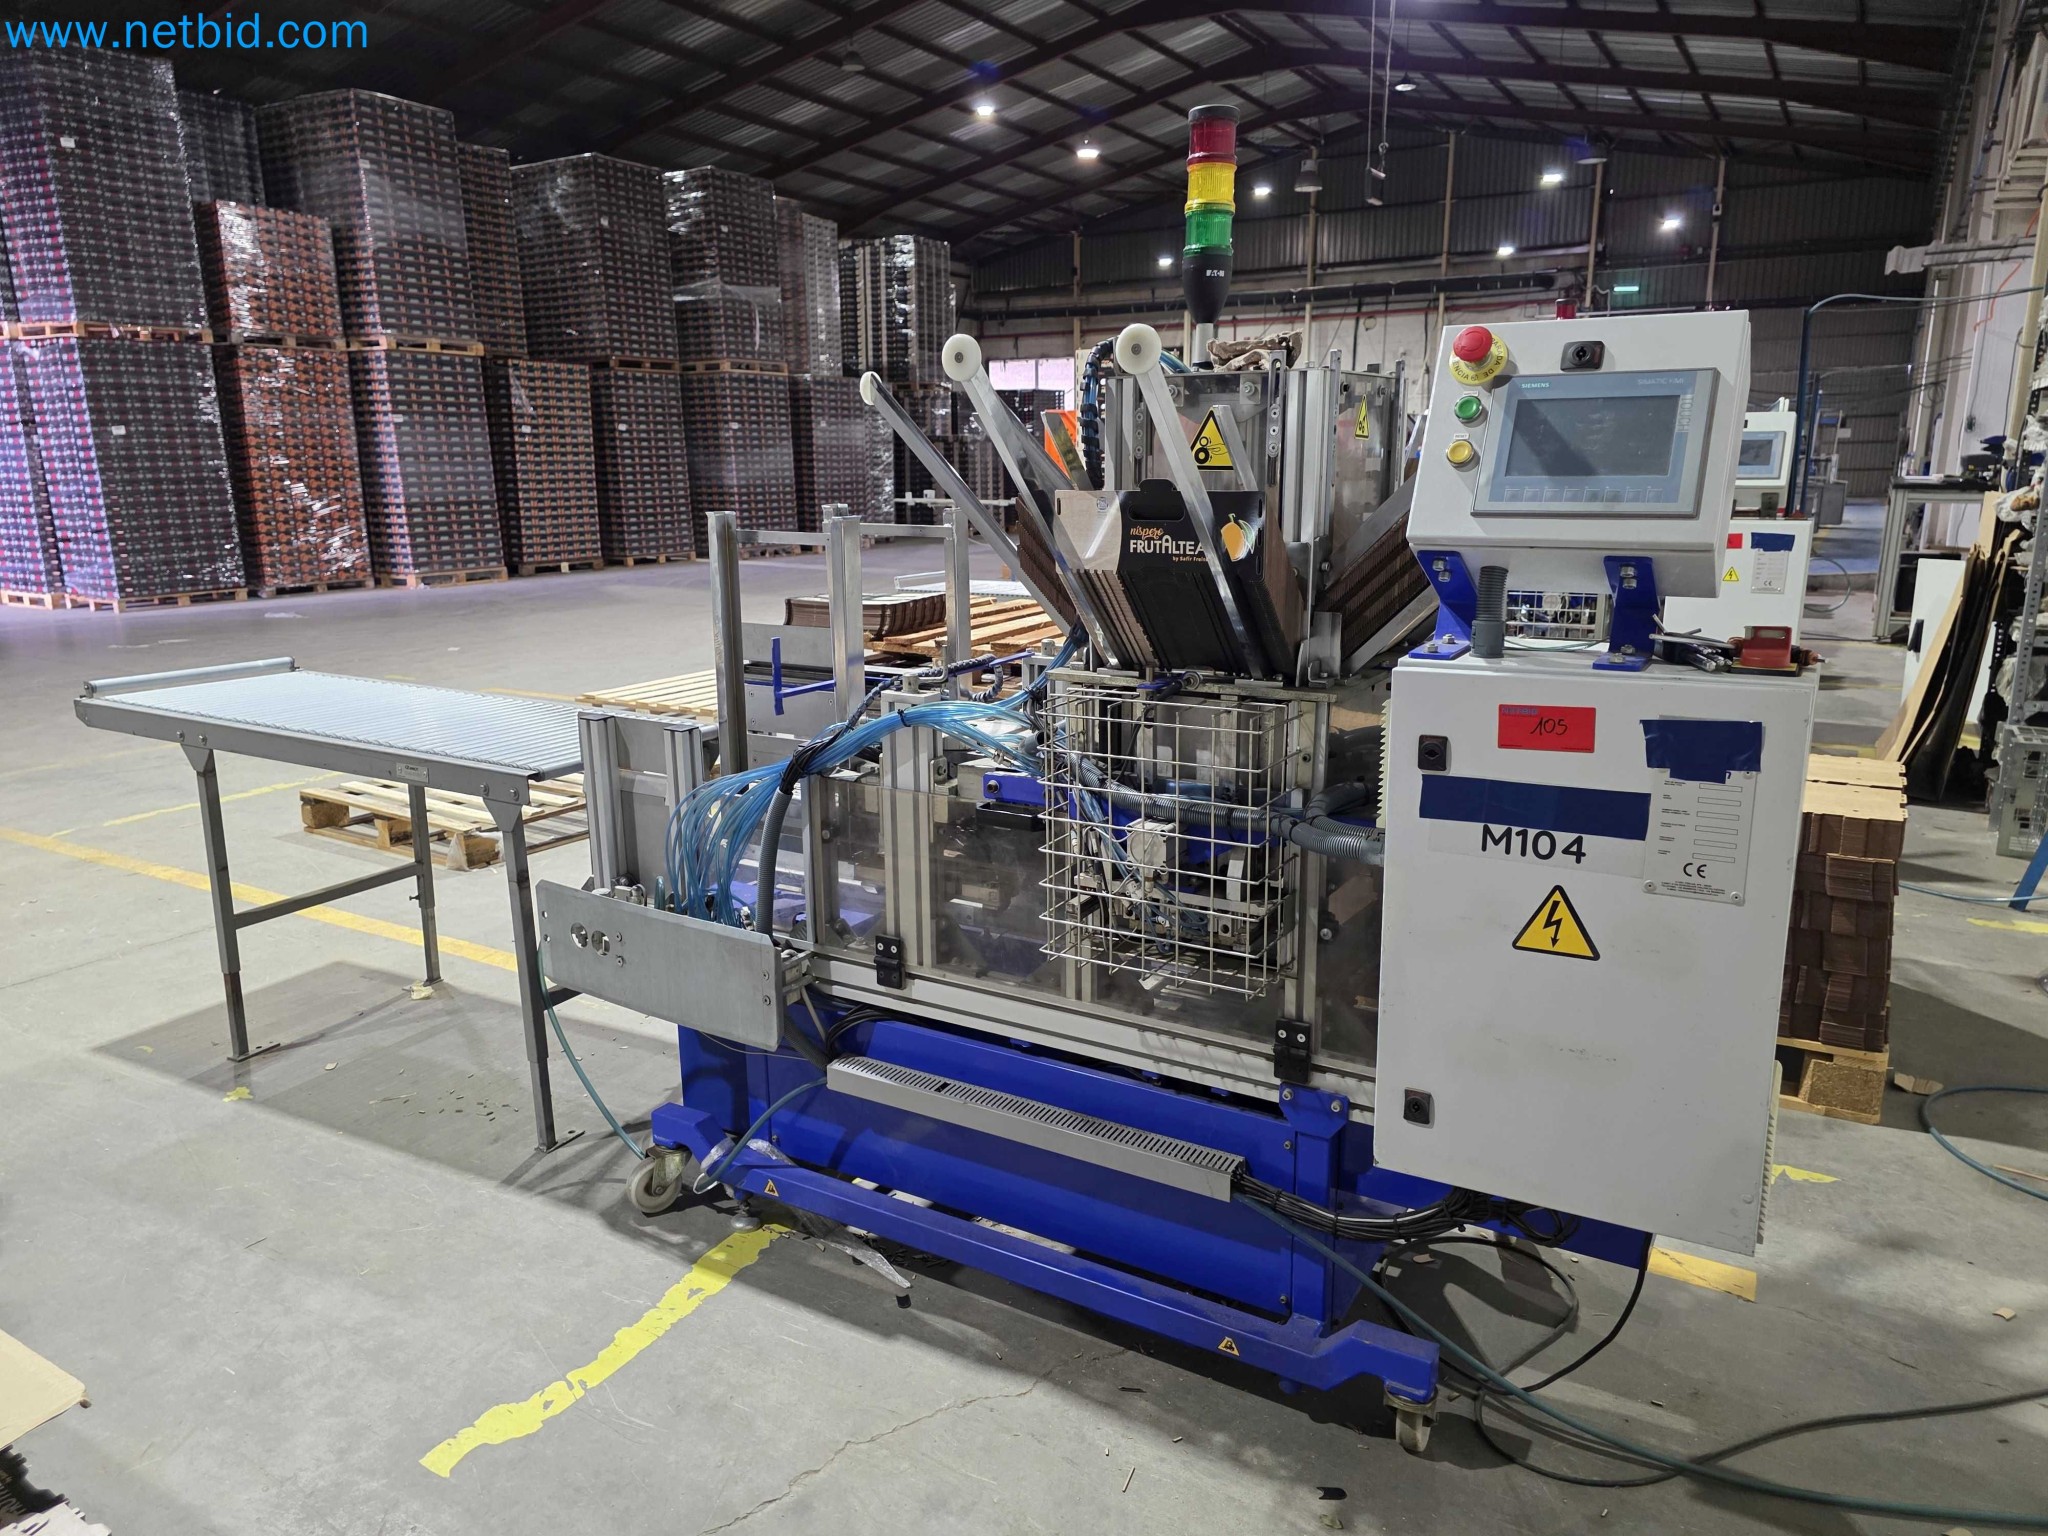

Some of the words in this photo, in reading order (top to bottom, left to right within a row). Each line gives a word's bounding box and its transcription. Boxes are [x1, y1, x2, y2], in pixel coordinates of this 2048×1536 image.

[1676, 396, 1694, 431] TOUCH
[1129, 535, 1205, 555] FRUTALTEA
[1529, 717, 1568, 736] 105
[1481, 823, 1587, 864] M104
